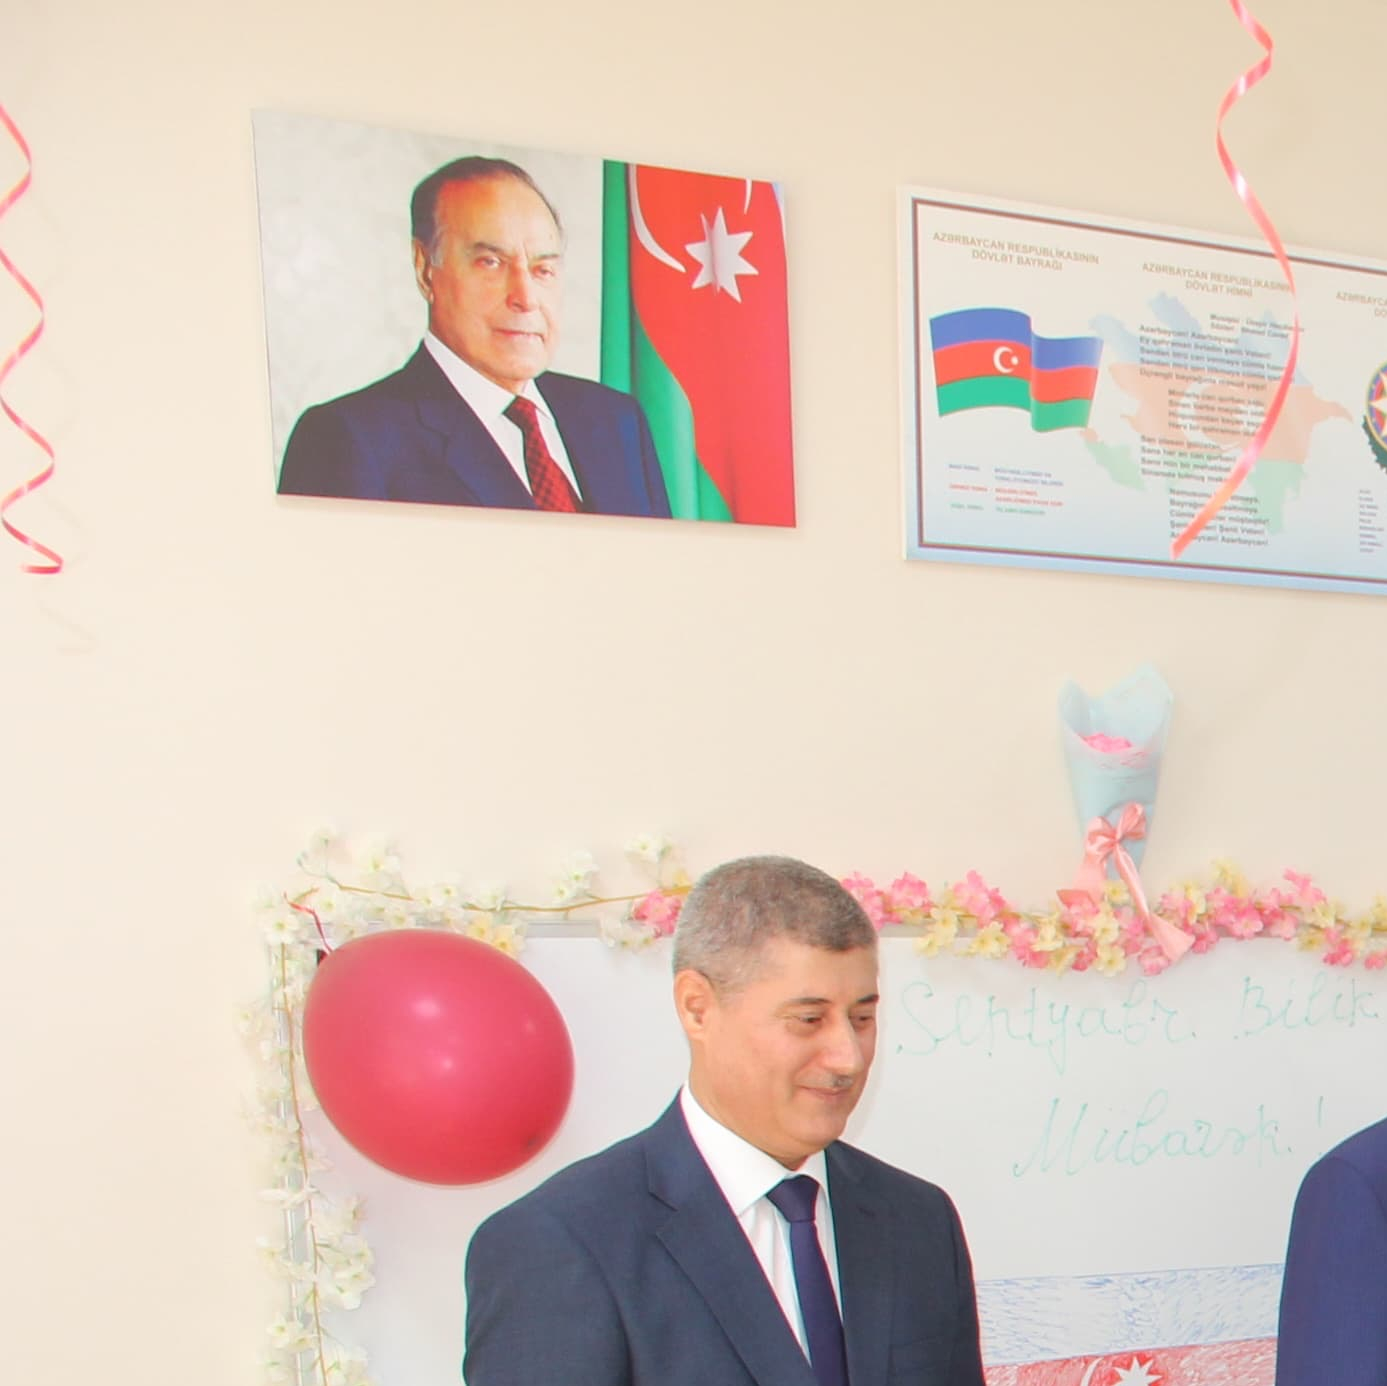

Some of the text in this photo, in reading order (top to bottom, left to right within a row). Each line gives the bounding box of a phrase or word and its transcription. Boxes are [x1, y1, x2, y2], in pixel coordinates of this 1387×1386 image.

[933, 232, 1005, 250] AZƏRBAYCAN
[972, 249, 1013, 263] DÖVLƏT
[1142, 263, 1207, 280] AZƏRBAYCAN
